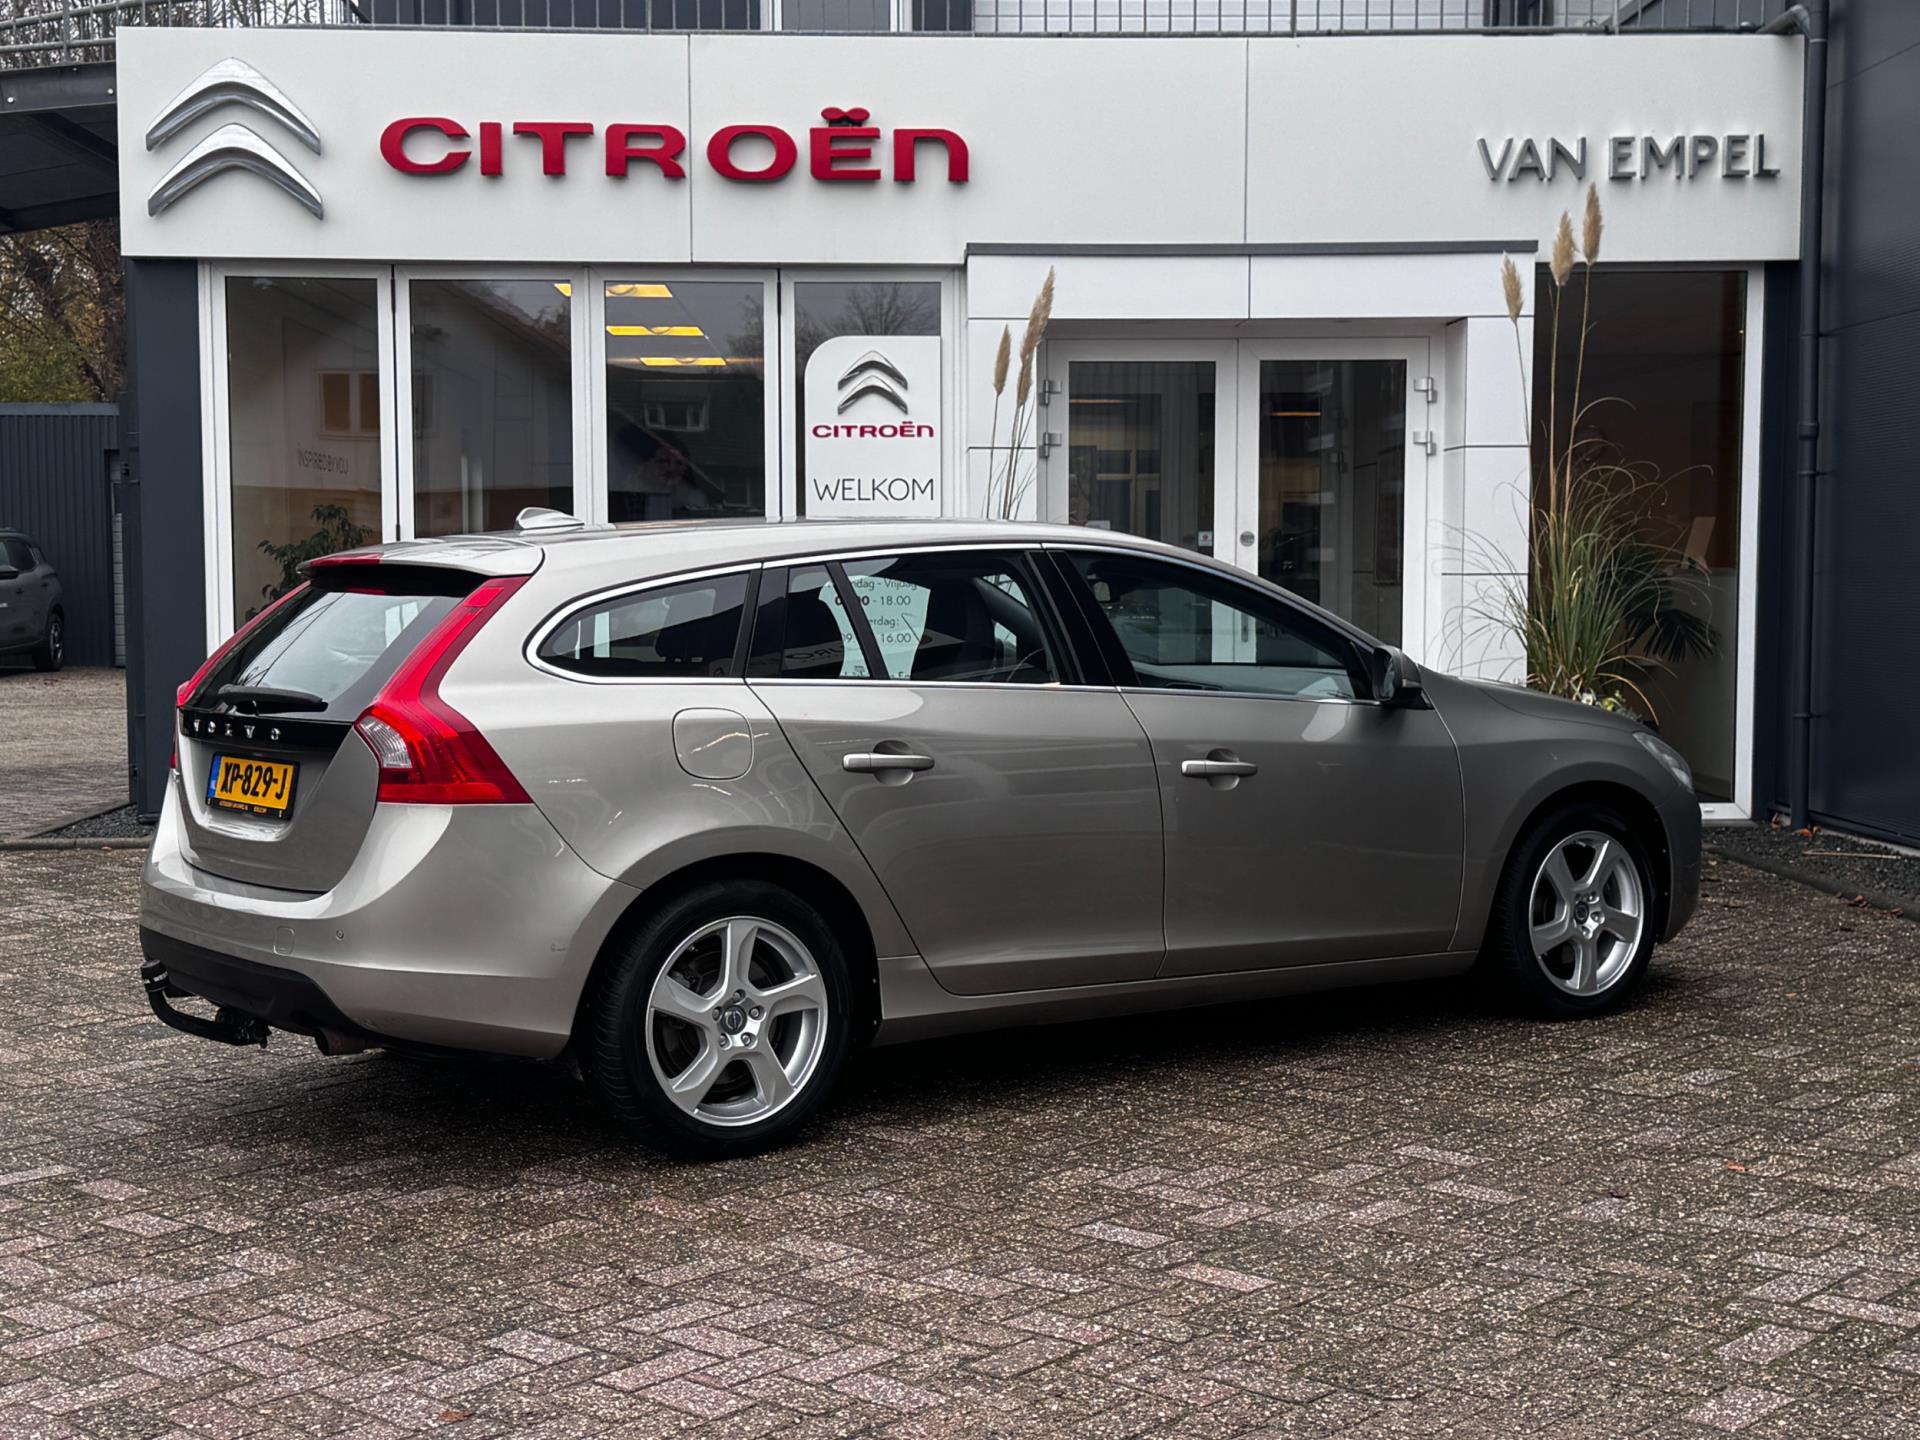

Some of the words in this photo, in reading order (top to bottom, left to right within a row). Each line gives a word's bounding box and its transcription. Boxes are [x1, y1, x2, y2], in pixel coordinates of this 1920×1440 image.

[1477, 136, 1587, 182] VAN
[1608, 133, 1781, 181] EMPEL
[813, 478, 935, 501] WELKOM
[880, 595, 911, 606] 18.00
[881, 632, 912, 643] 16.00
[193, 719, 281, 741] VOLVO
[220, 761, 289, 800] XP-829-J
